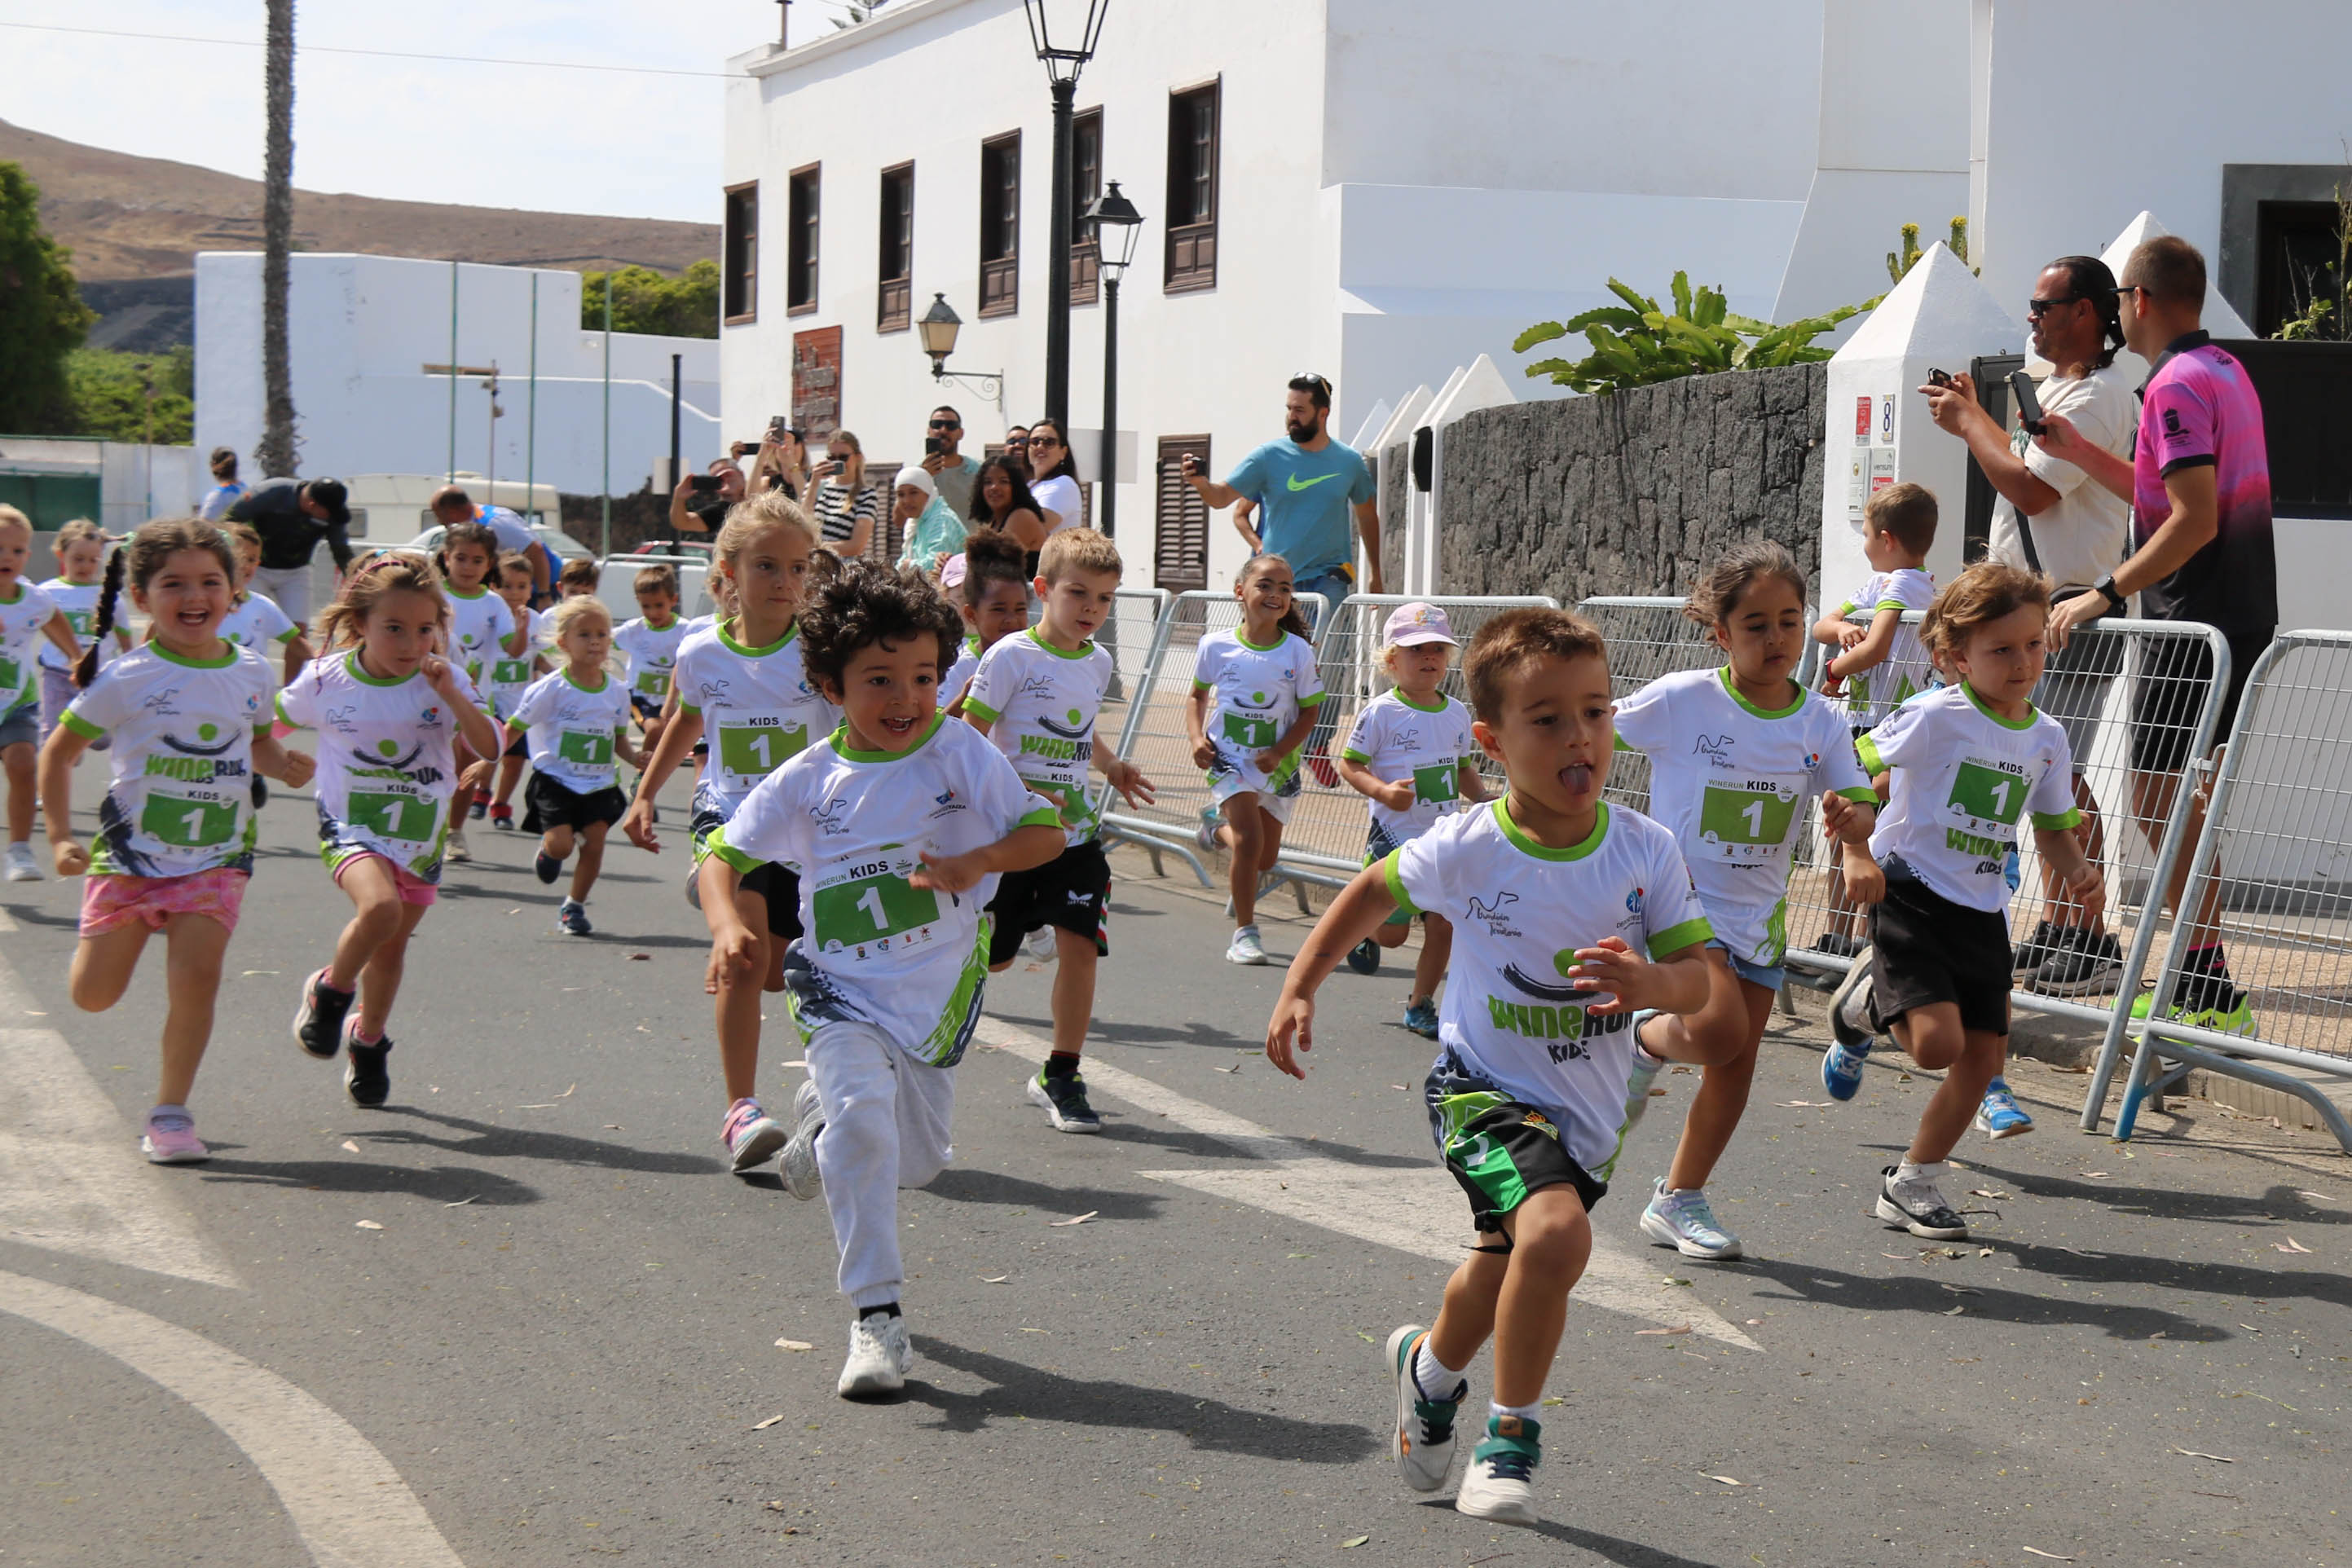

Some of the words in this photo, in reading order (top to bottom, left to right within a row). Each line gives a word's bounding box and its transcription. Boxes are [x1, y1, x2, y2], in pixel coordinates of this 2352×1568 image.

[1883, 402, 1891, 432] 8
[75, 616, 86, 632] 1
[506, 664, 518, 680] 1
[653, 677, 663, 692] 1
[749, 716, 779, 726] KIDS
[1243, 723, 1256, 745] 1
[584, 738, 597, 760] 1
[749, 734, 771, 768] 1
[1438, 756, 1454, 765] KIDS
[1965, 755, 1997, 769] WINERUN
[1998, 760, 2024, 775] KIDS
[1051, 773, 1073, 782] KIDS
[1441, 769, 1454, 796] 1
[1708, 778, 1744, 790] WINERUN
[1746, 780, 1777, 791] KIDS
[187, 790, 219, 801] KIDS
[386, 784, 417, 795] KIDS
[1990, 780, 2011, 816] 1
[180, 808, 205, 842] 1
[381, 800, 404, 832] 1
[1742, 800, 1764, 837] 1
[815, 873, 848, 890] WINERUN
[849, 860, 889, 879] KIDS
[1975, 861, 2002, 875] KIDS
[857, 886, 890, 930] 1
